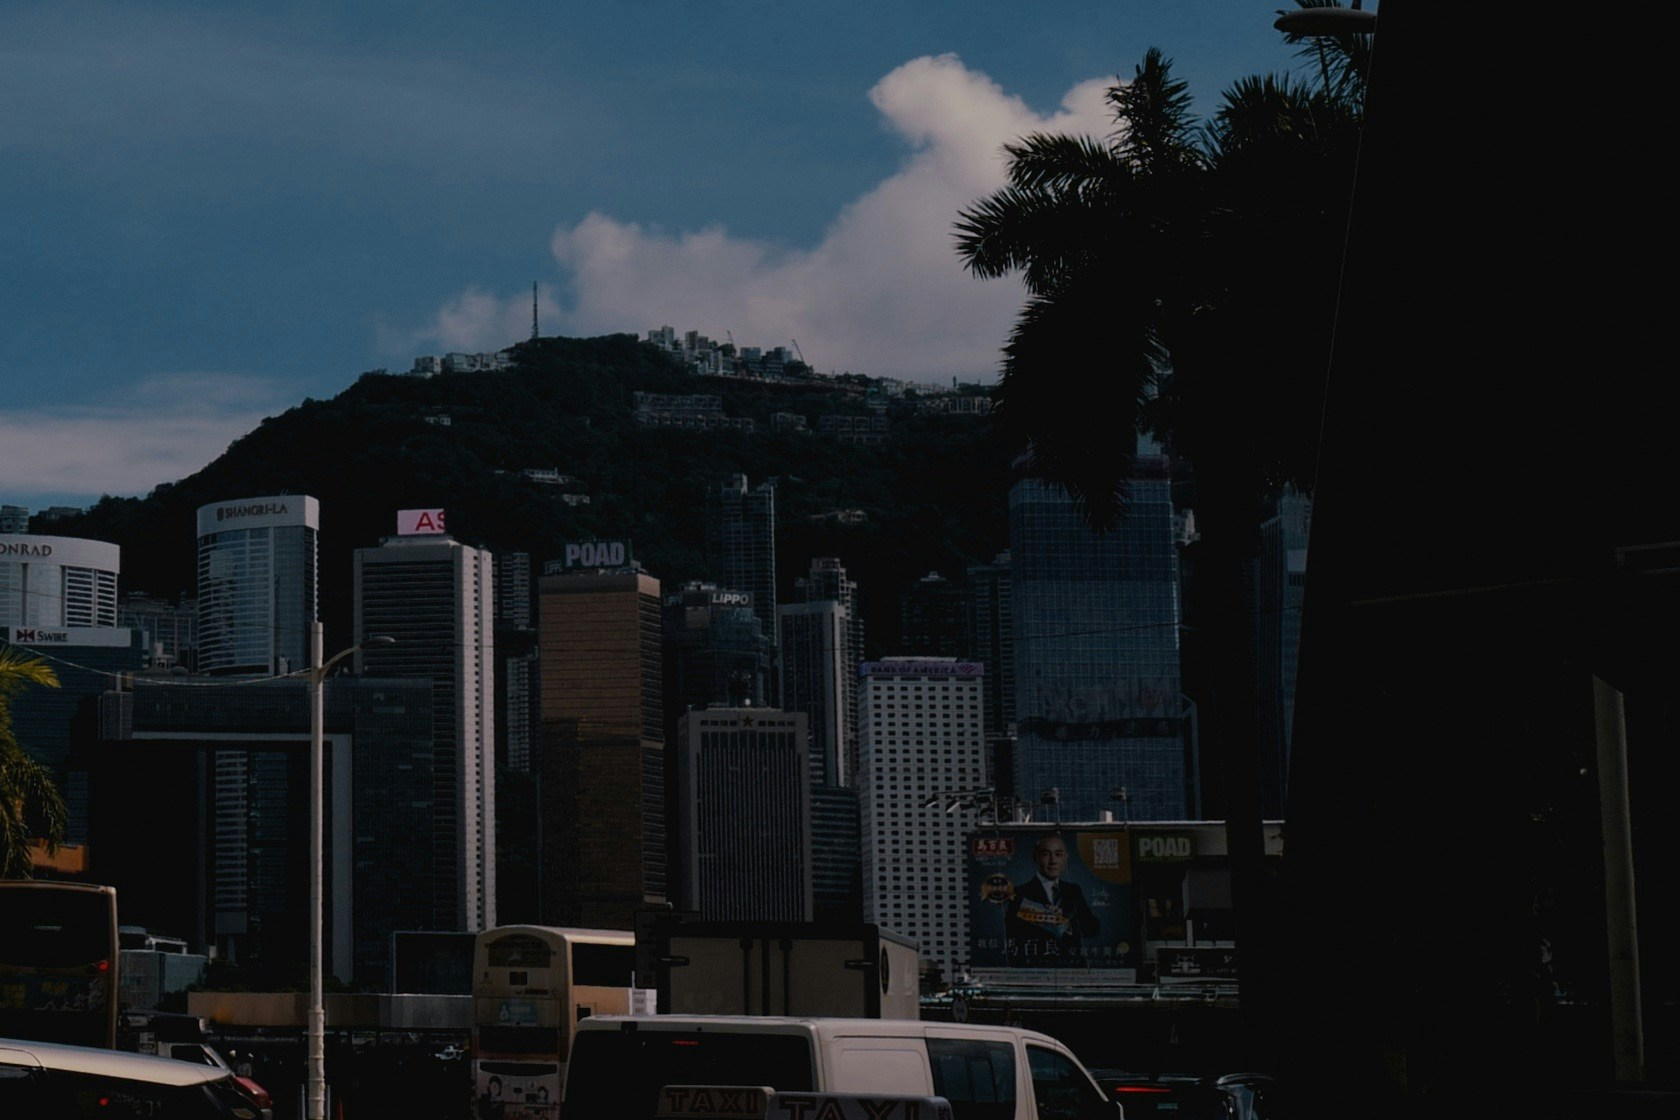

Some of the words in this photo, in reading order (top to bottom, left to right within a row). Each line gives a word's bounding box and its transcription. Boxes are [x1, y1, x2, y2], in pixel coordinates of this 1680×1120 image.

[225, 504, 288, 519] SHANGRI-LA
[565, 542, 625, 567] POAD
[712, 593, 749, 606] LIPPO
[871, 666, 897, 674] BANK
[913, 666, 956, 675] AMERICA
[1138, 836, 1191, 857] POAD
[666, 1088, 760, 1114] TAXI
[779, 1096, 924, 1120] TAXI
